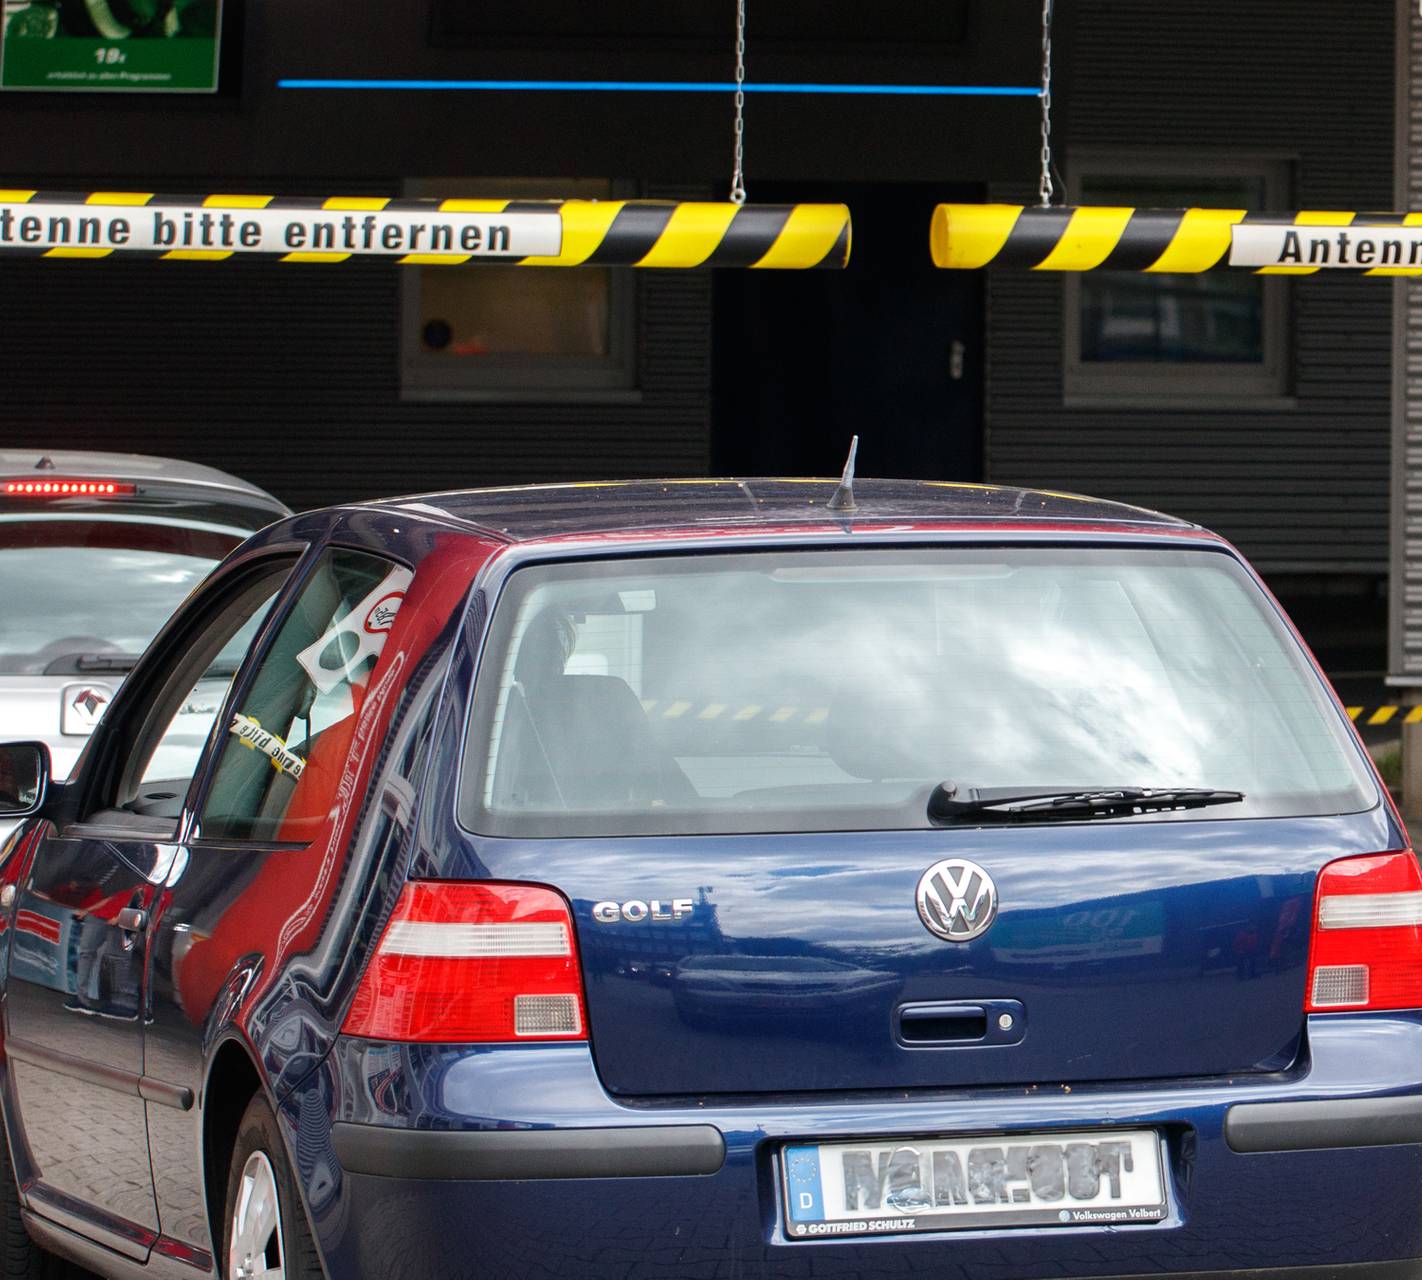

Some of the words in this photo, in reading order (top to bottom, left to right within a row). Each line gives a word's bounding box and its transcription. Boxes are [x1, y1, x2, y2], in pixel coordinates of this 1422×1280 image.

[152, 211, 262, 248] bitte
[284, 215, 511, 252] entfernen
[592, 898, 694, 923] GOLF
[800, 1192, 813, 1209] D
[1073, 1210, 1127, 1221] Volkswagen
[1128, 1208, 1161, 1218] Velbert
[808, 1221, 868, 1234] GOTTFRIED
[868, 1219, 916, 1231] SCHULTZ
